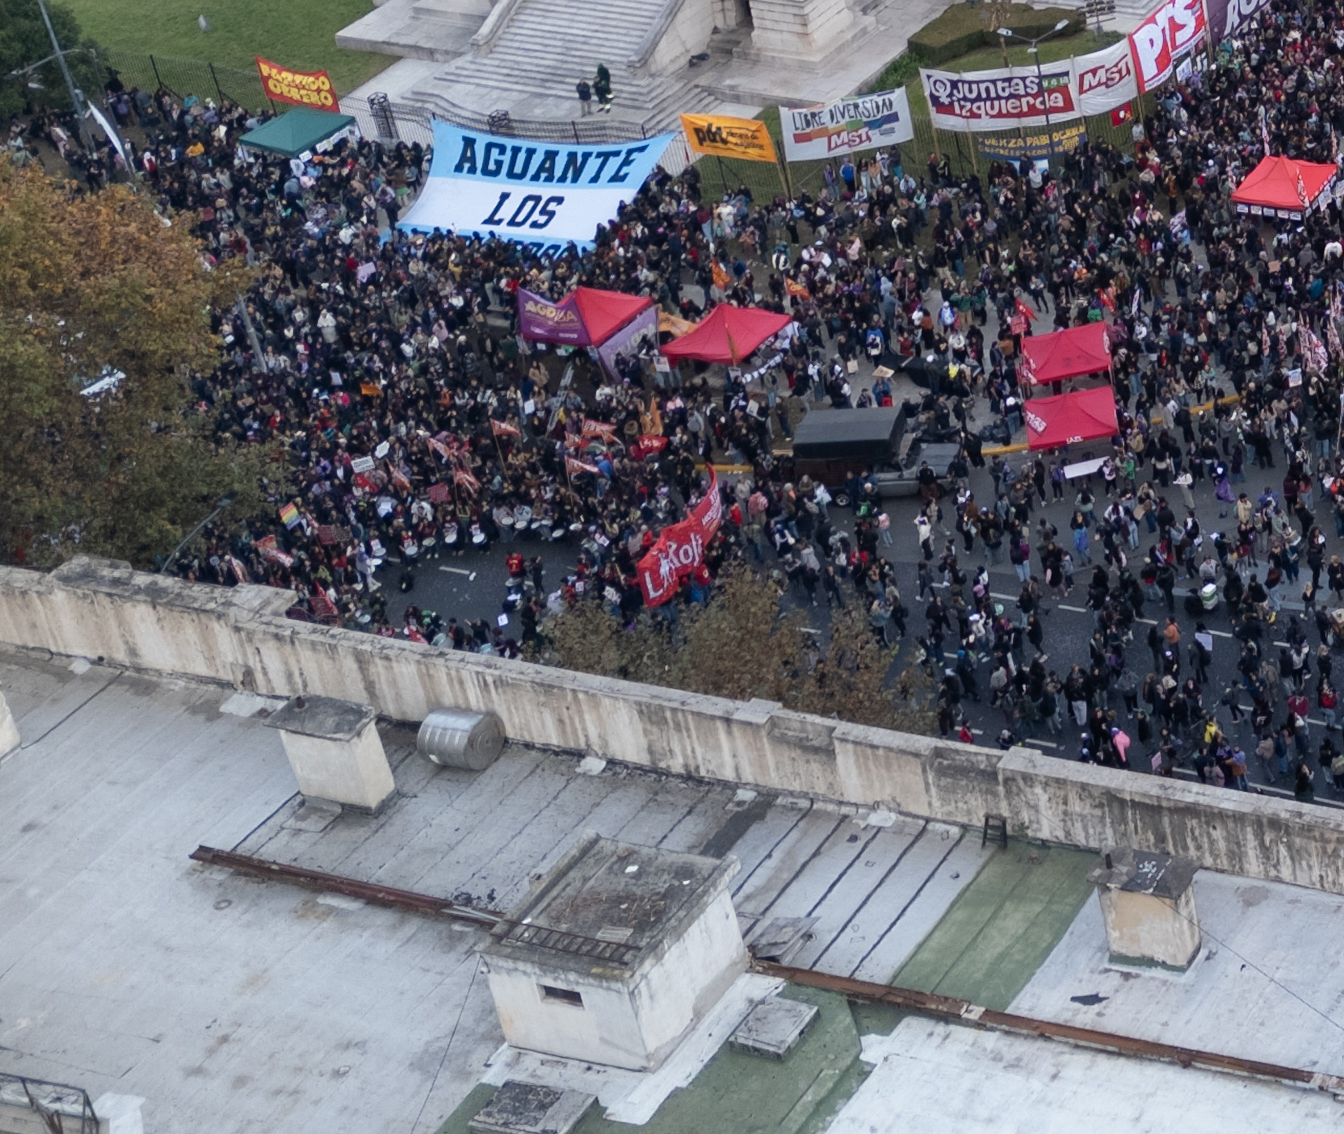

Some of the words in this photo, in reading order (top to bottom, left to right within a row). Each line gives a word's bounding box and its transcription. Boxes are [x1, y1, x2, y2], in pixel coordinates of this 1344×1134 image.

[259, 62, 331, 91] PARTIDO
[268, 78, 334, 106] OBRERO
[1082, 60, 1131, 93] MST
[792, 110, 824, 131] LIBRE
[830, 97, 894, 125] DIVERSIDAD
[953, 92, 1064, 118] izquierda
[830, 128, 871, 149] MST
[454, 135, 650, 184] AGUANTE
[481, 191, 565, 229] LOS
